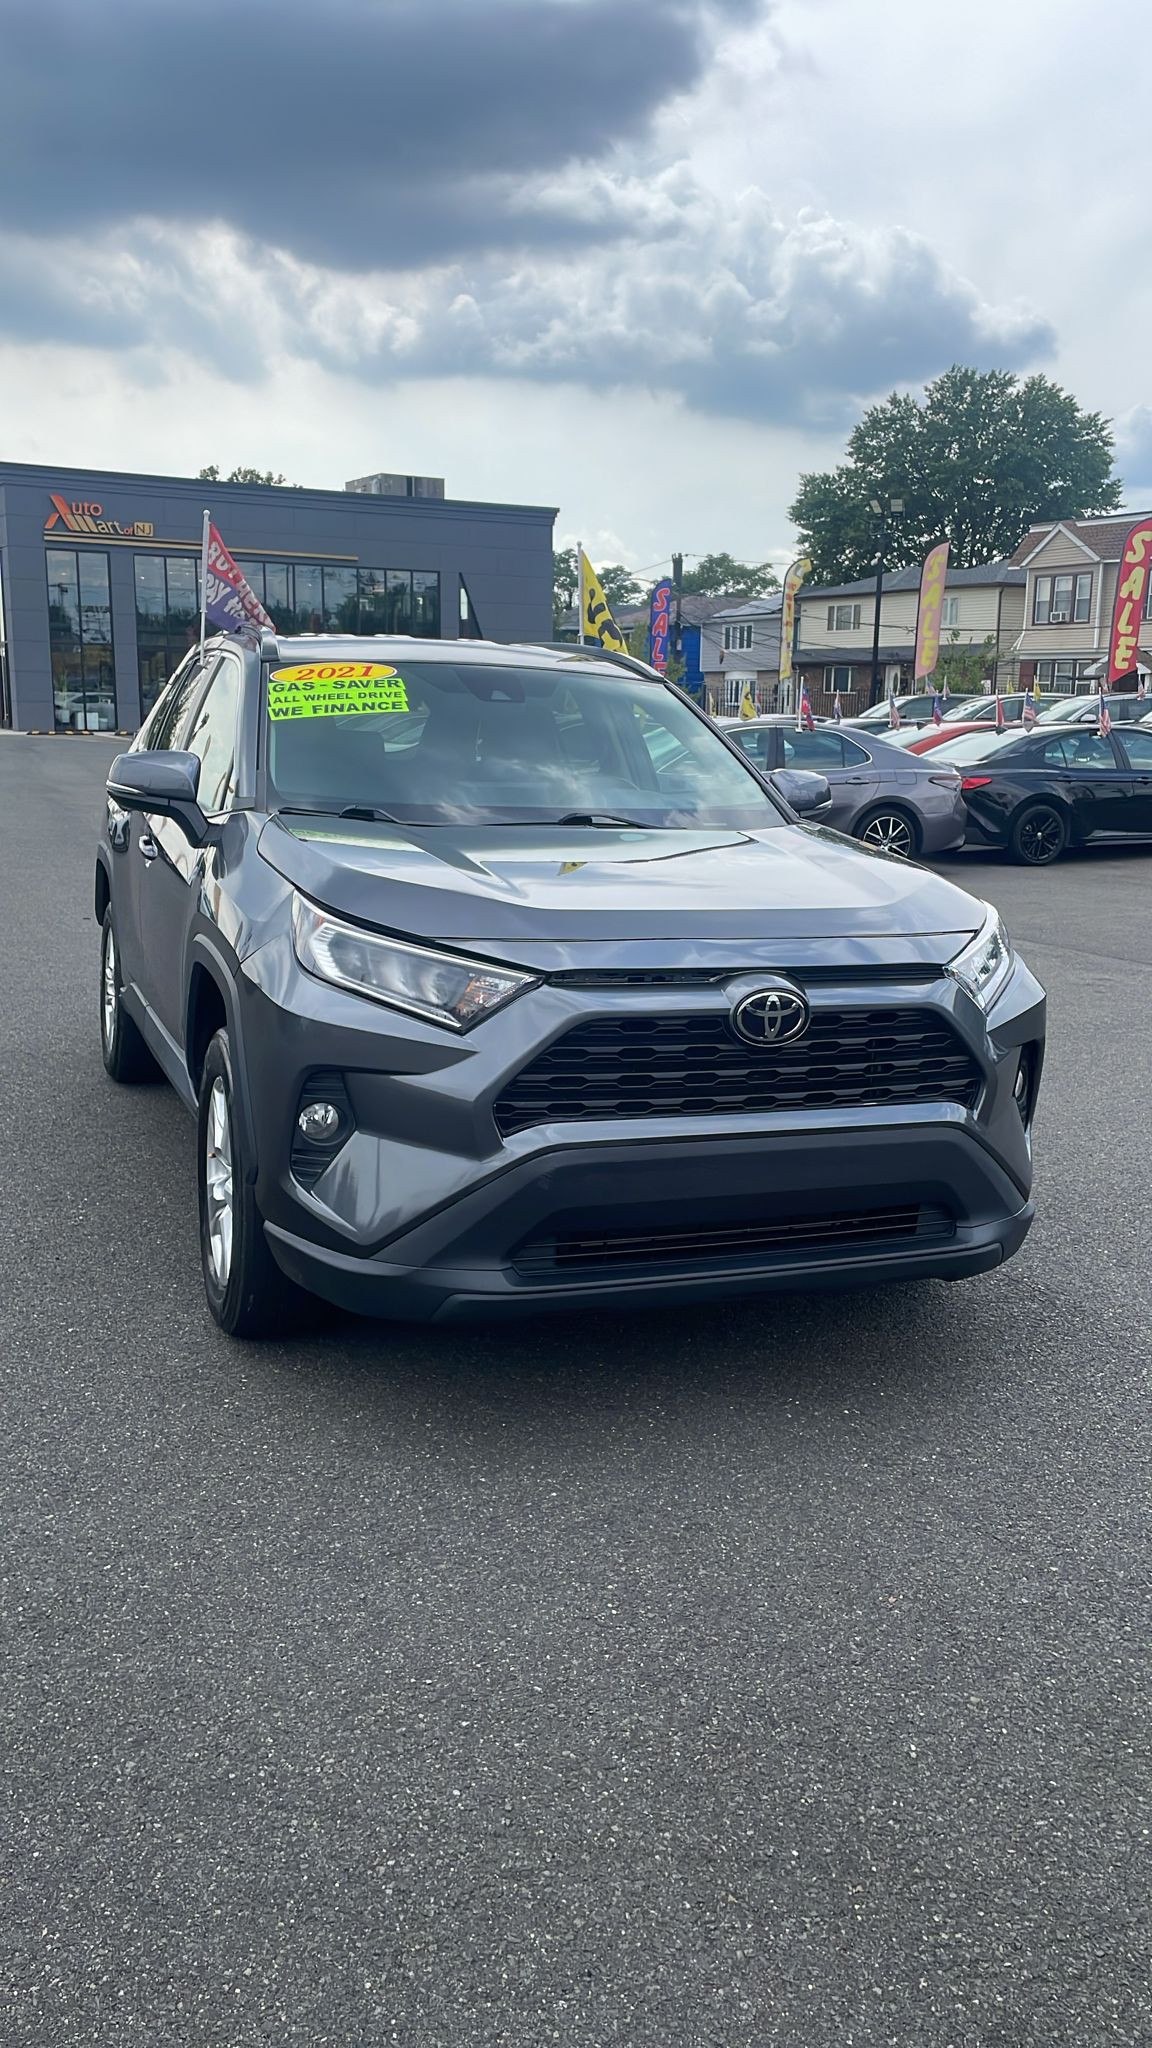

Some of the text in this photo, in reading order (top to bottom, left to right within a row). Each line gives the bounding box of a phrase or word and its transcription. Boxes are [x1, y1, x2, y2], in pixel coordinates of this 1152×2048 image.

[135, 522, 153, 536] NJ
[1115, 531, 1152, 669] SALE
[920, 554, 946, 668] SALE
[294, 665, 374, 681] 2021
[272, 681, 315, 693] GAS
[332, 679, 401, 690] SAVER
[273, 691, 402, 704] ALL WHEEL DRIVE
[271, 701, 404, 718] WE FINANCE
